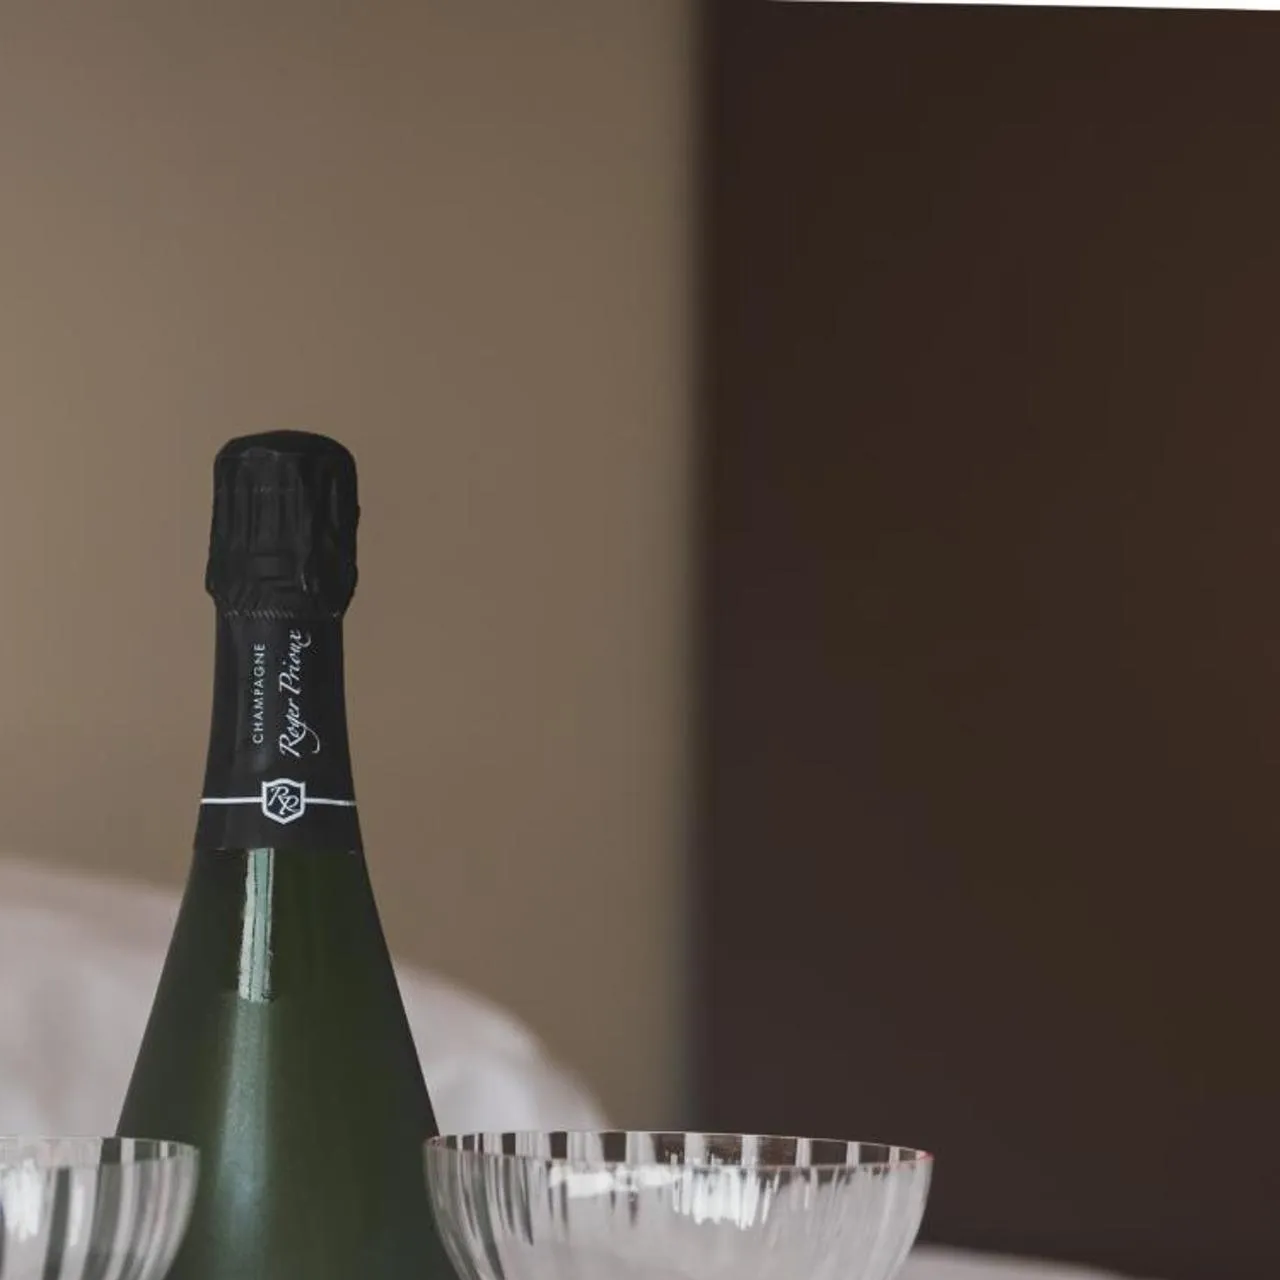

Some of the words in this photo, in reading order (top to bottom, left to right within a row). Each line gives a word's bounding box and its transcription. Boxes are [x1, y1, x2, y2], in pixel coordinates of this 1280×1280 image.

[252, 642, 266, 744] CHAMPAGNE
[278, 629, 312, 696] Prioux
[279, 697, 320, 758] Roger
